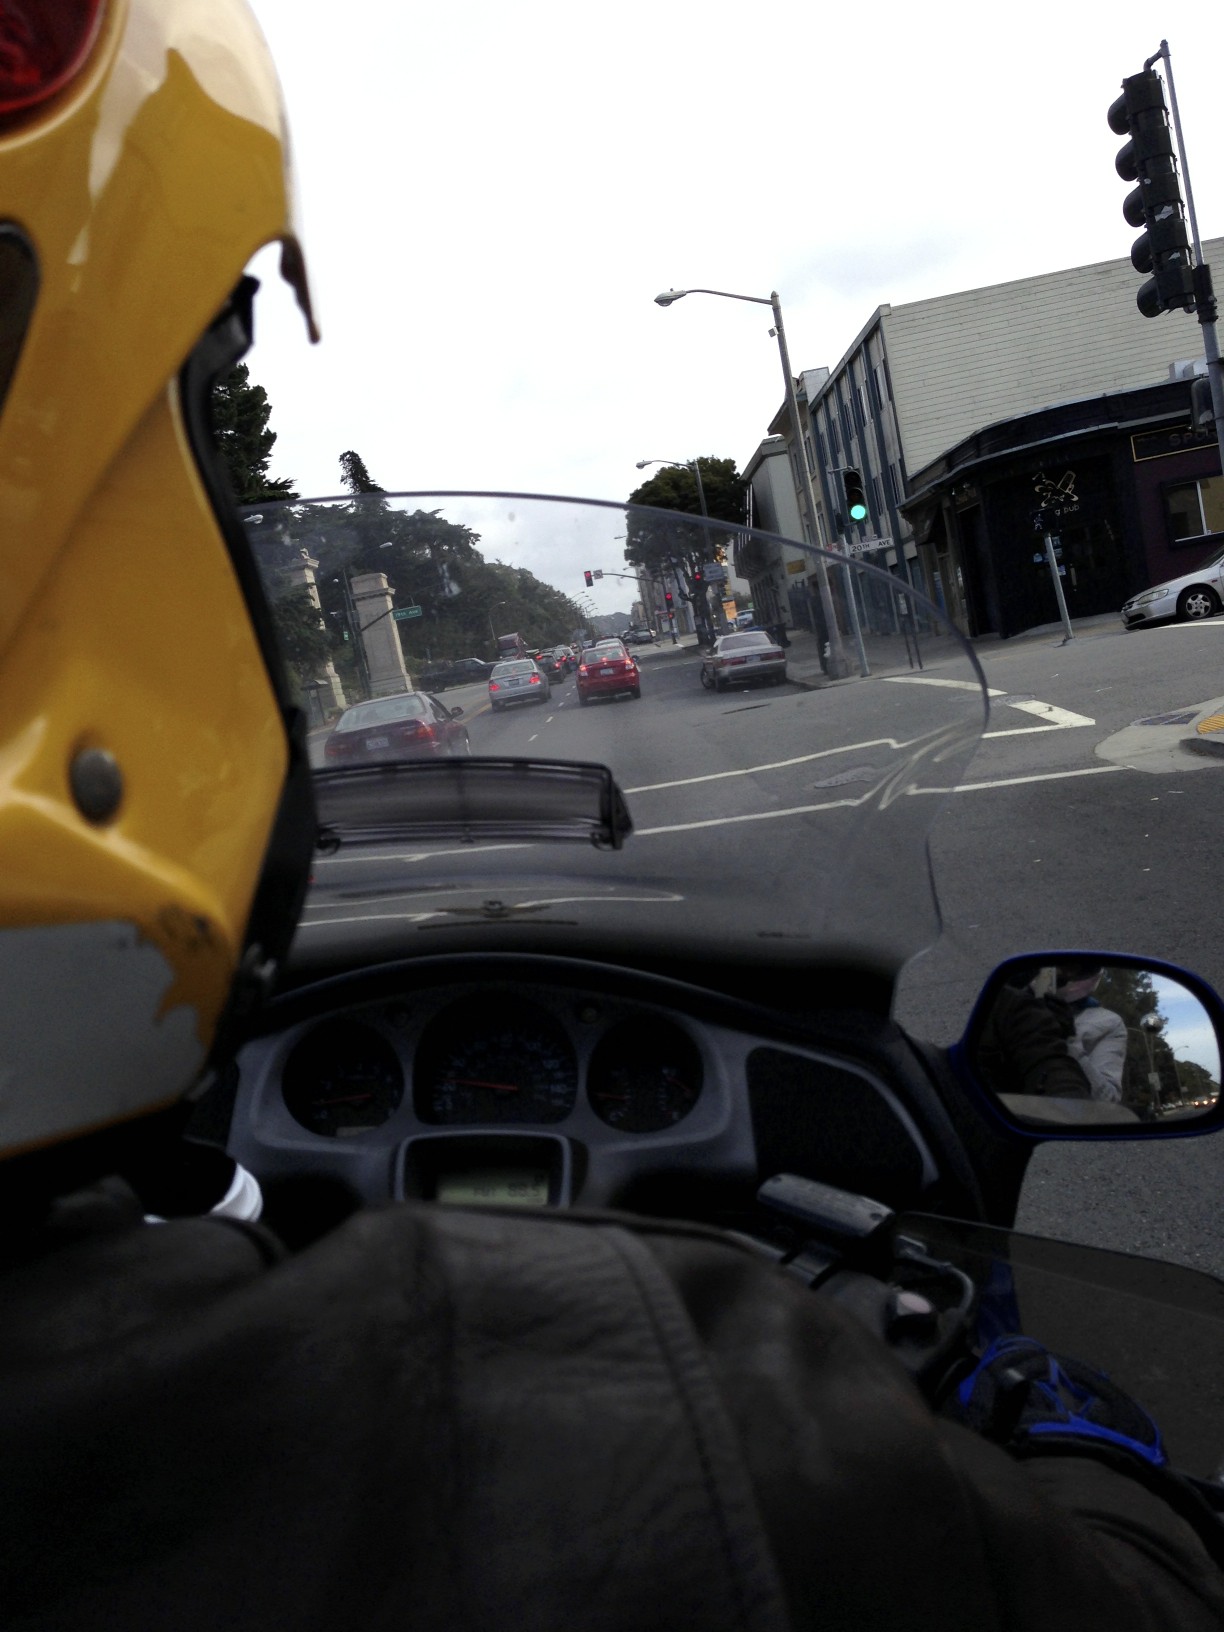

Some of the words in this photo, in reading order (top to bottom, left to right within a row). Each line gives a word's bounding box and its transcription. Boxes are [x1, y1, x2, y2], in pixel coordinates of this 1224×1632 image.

[1063, 503, 1080, 514] pub
[851, 544, 870, 552] 20TH
[878, 539, 891, 547] AVE
